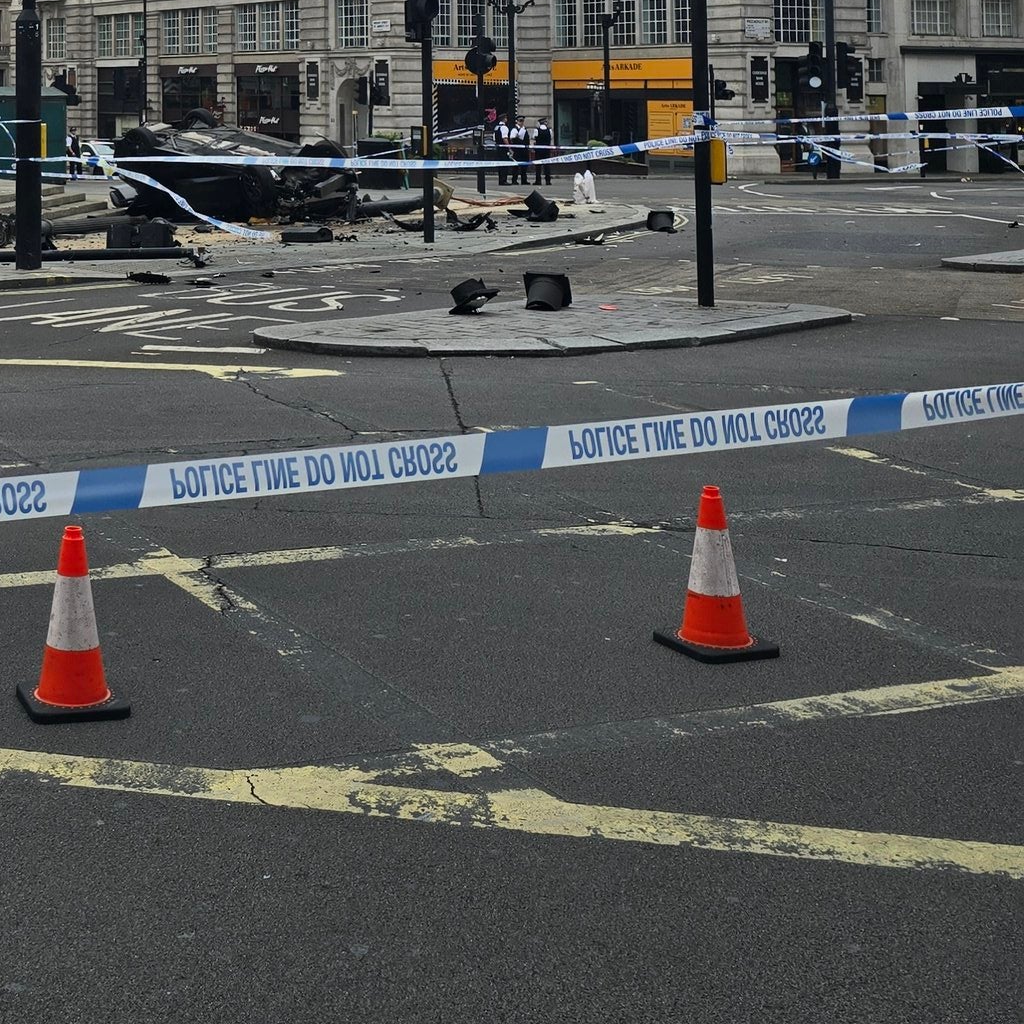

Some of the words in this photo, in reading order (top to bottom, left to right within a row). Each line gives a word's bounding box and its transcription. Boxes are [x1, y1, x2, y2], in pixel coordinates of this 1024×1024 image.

[615, 63, 643, 71] ARKADE
[980, 108, 1002, 116] POLICE
[644, 140, 664, 148] POLICE
[596, 148, 614, 157] CROSS
[138, 281, 406, 312] BUS
